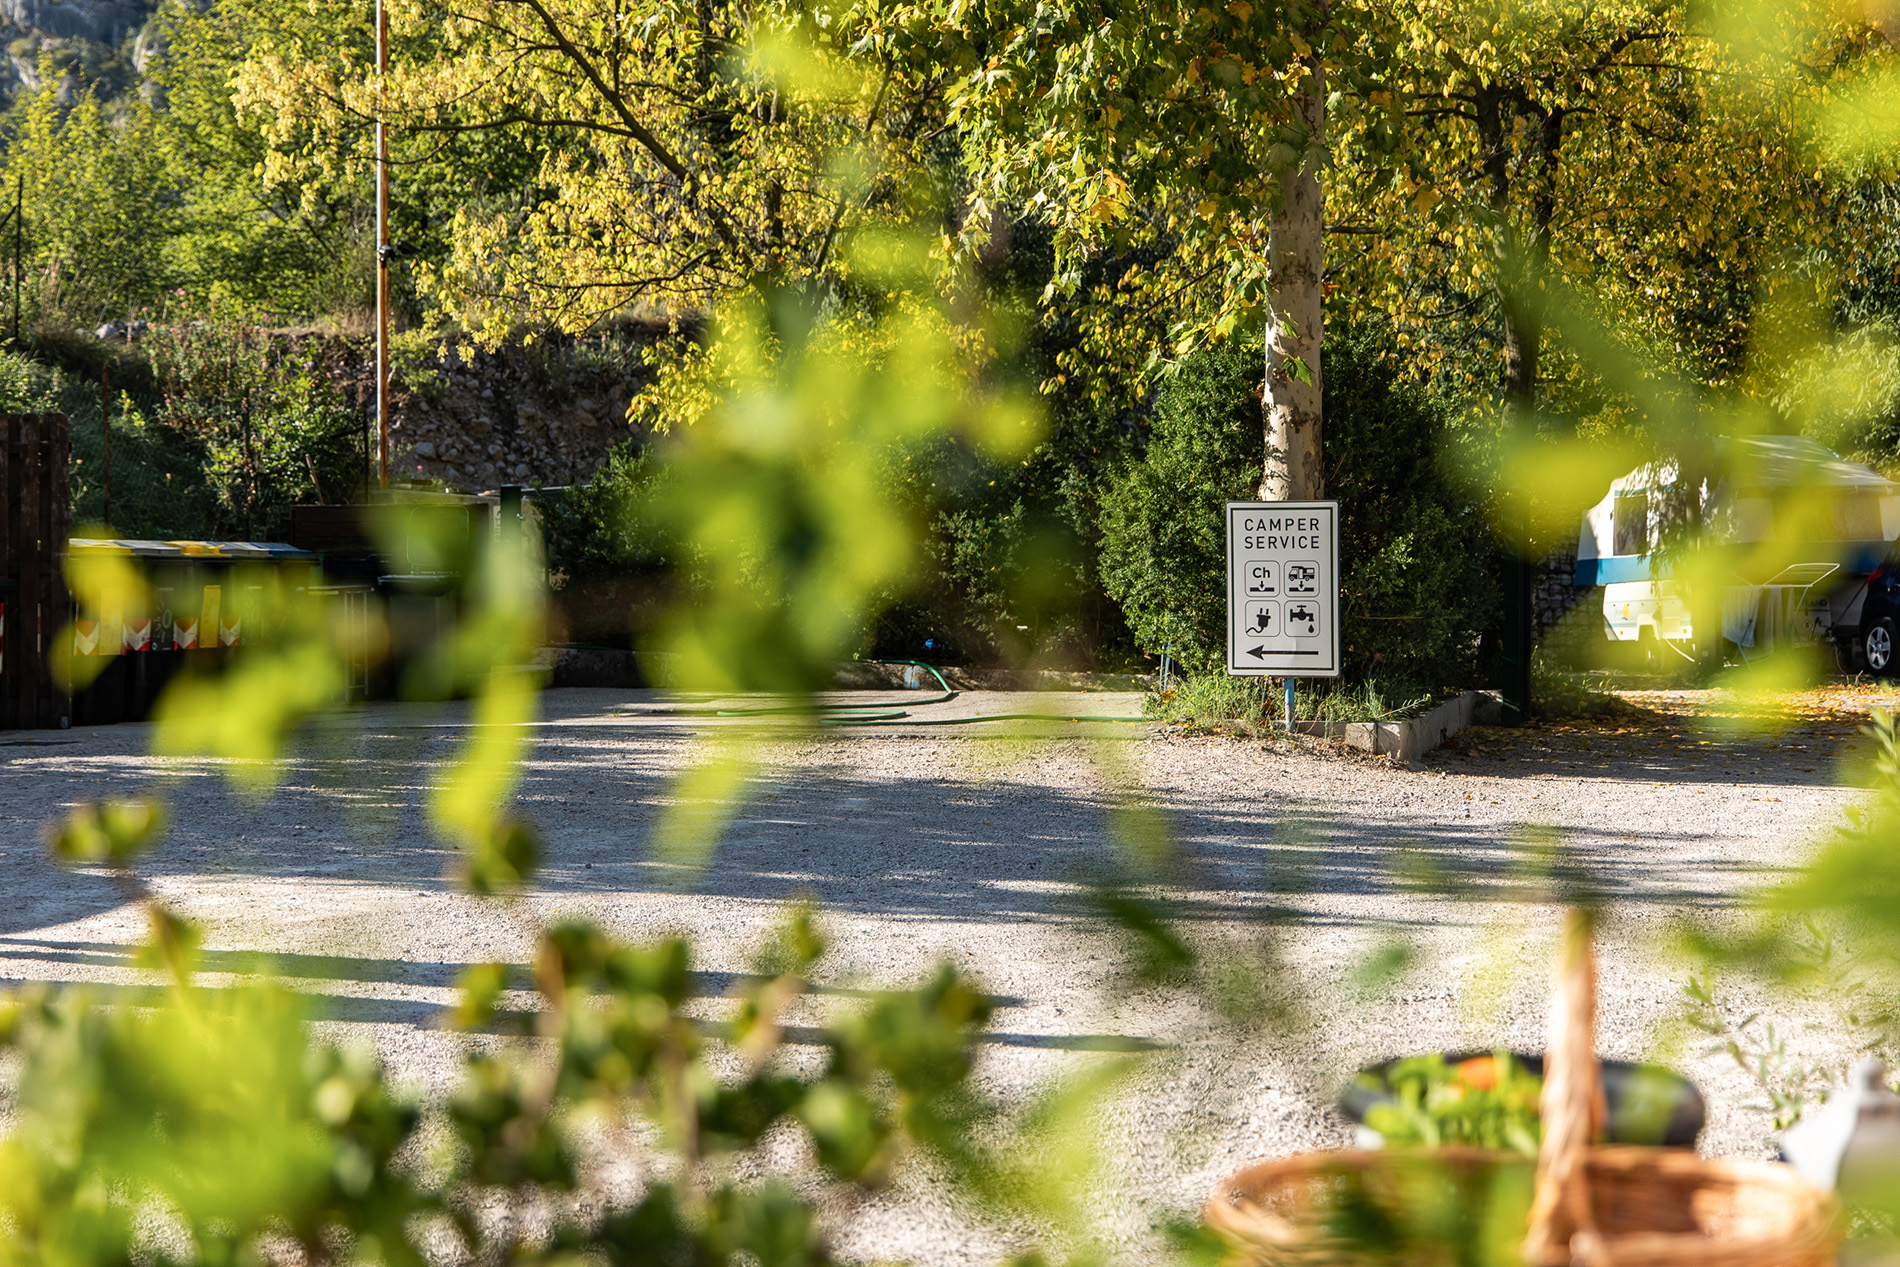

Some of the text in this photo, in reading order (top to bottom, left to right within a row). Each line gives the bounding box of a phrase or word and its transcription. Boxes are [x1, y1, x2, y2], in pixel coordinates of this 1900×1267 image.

[1244, 518, 1319, 531] CAMPER
[1244, 536, 1320, 549] SERVICE
[1252, 567, 1270, 578] Ch
